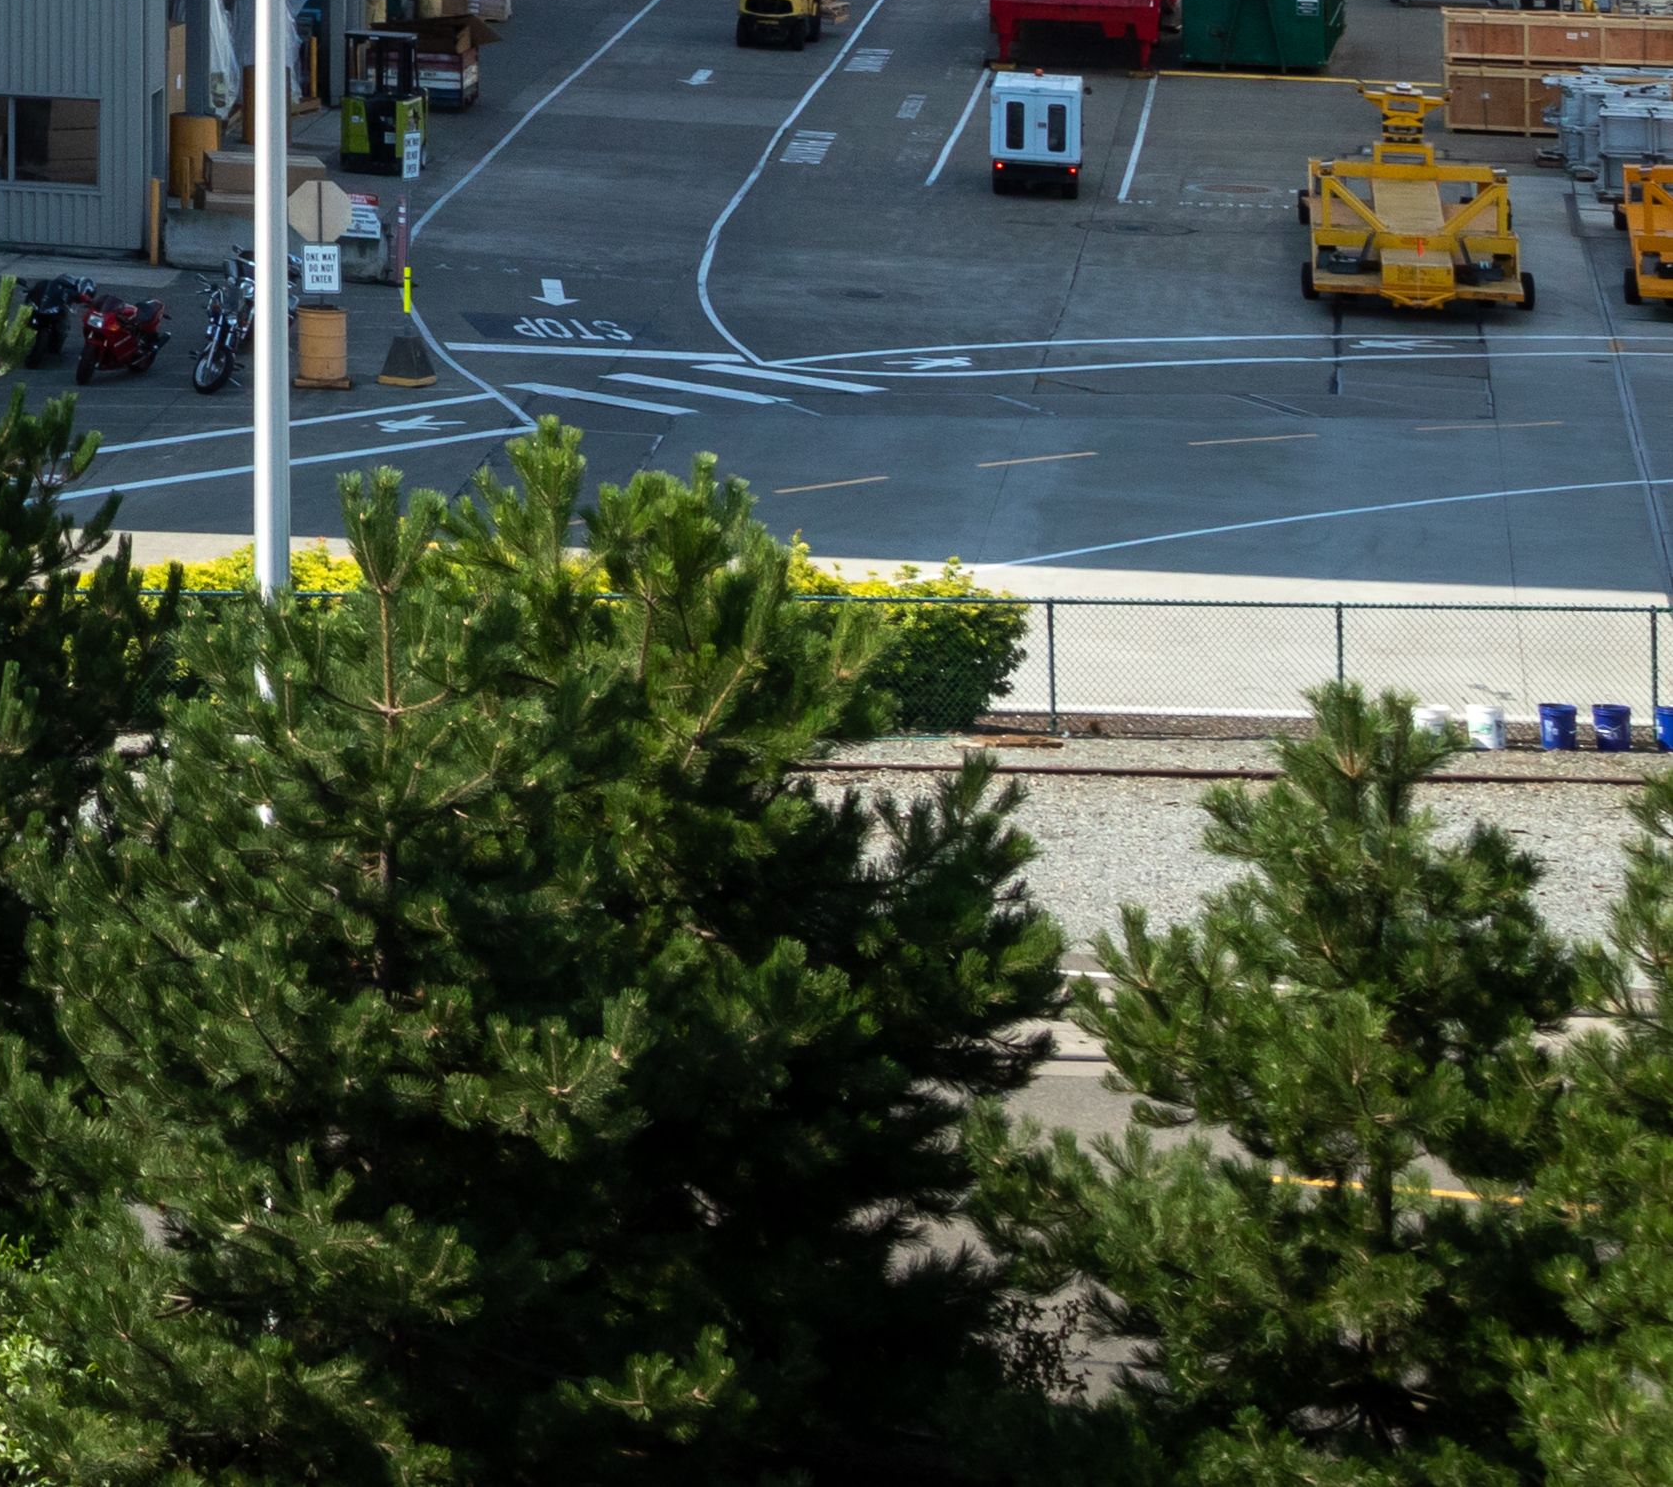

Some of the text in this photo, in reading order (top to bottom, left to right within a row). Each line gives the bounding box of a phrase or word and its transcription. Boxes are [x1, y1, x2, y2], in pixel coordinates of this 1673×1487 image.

[306, 253, 336, 261] ONE WAY
[309, 264, 334, 273] DO NOT
[311, 275, 333, 283] ENTER
[513, 316, 633, 341] STOP
